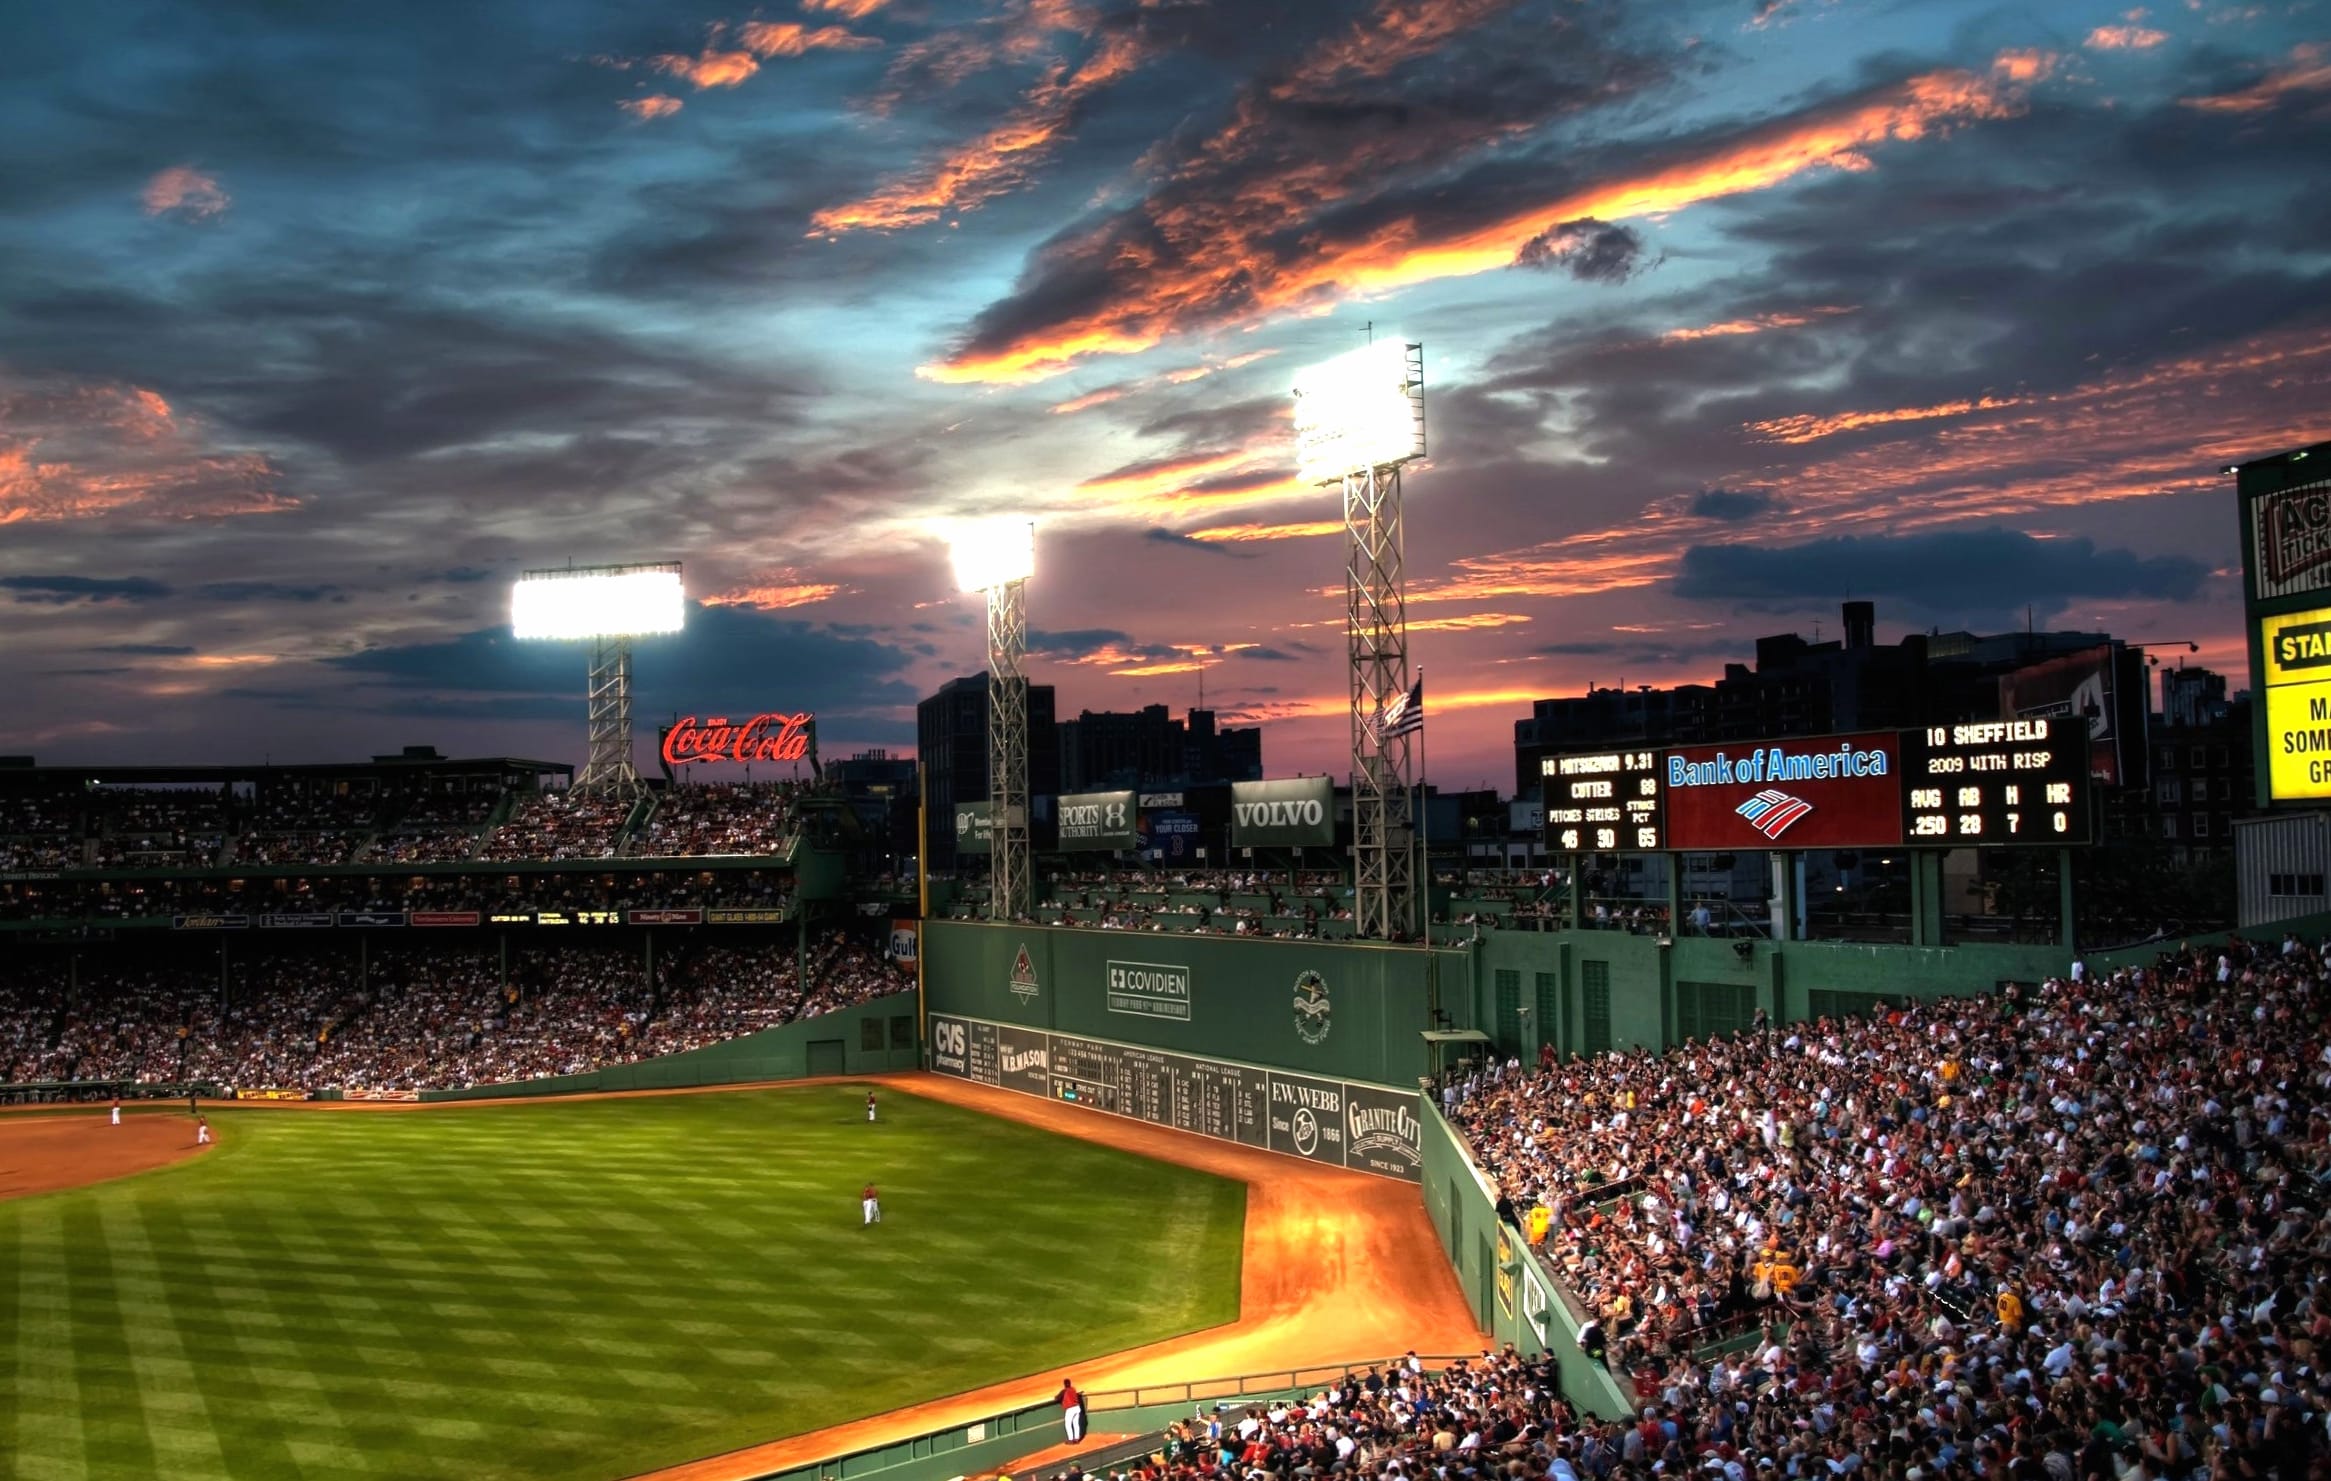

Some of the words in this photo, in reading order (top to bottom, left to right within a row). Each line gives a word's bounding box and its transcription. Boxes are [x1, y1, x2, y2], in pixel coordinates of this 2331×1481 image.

[663, 713, 813, 764] Coca-Cola
[1927, 728, 1946, 746] 10
[1954, 720, 2048, 745] SHEFFIELD
[1625, 752, 1653, 770] 9.31
[1668, 753, 1734, 787] Bank
[1735, 749, 1763, 783] of
[1766, 743, 1887, 781] America
[1928, 757, 1964, 773] 2009
[1970, 755, 2007, 771] WITH
[2013, 752, 2051, 769] RISP
[1571, 781, 1612, 798] CUTTER
[1641, 778, 1656, 795] 88
[1911, 789, 1941, 808] AVG
[1958, 787, 1980, 806] AB
[2006, 785, 2018, 805] H
[2046, 784, 2070, 803] HR
[1234, 800, 1323, 827] VOLVO
[1549, 809, 1582, 823] PITCHES
[1585, 807, 1620, 822] STRIKES
[1632, 813, 1650, 823] PCT
[1909, 816, 1946, 835] .250
[1960, 815, 1981, 834] 28
[2007, 813, 2019, 833] 7
[2053, 811, 2067, 832] 0
[1155, 824, 1172, 834] YOUR
[1174, 823, 1198, 833] CLOSER
[1638, 827, 1656, 847] 65
[1127, 970, 1185, 994] COVIDIEN
[935, 1021, 965, 1055] CVS
[936, 1053, 965, 1072] pharmacy
[1196, 1063, 1220, 1074] NATIONAL
[1221, 1067, 1241, 1077] LEAGUE
[1272, 1082, 1297, 1105] F.W.
[1297, 1086, 1340, 1113] WEBB
[1272, 1116, 1289, 1132] Since
[1322, 1127, 1341, 1143] 1866
[1349, 1100, 1397, 1139] GRANITE
[1370, 1159, 1389, 1170] SINCE
[1390, 1162, 1405, 1174] 1923
